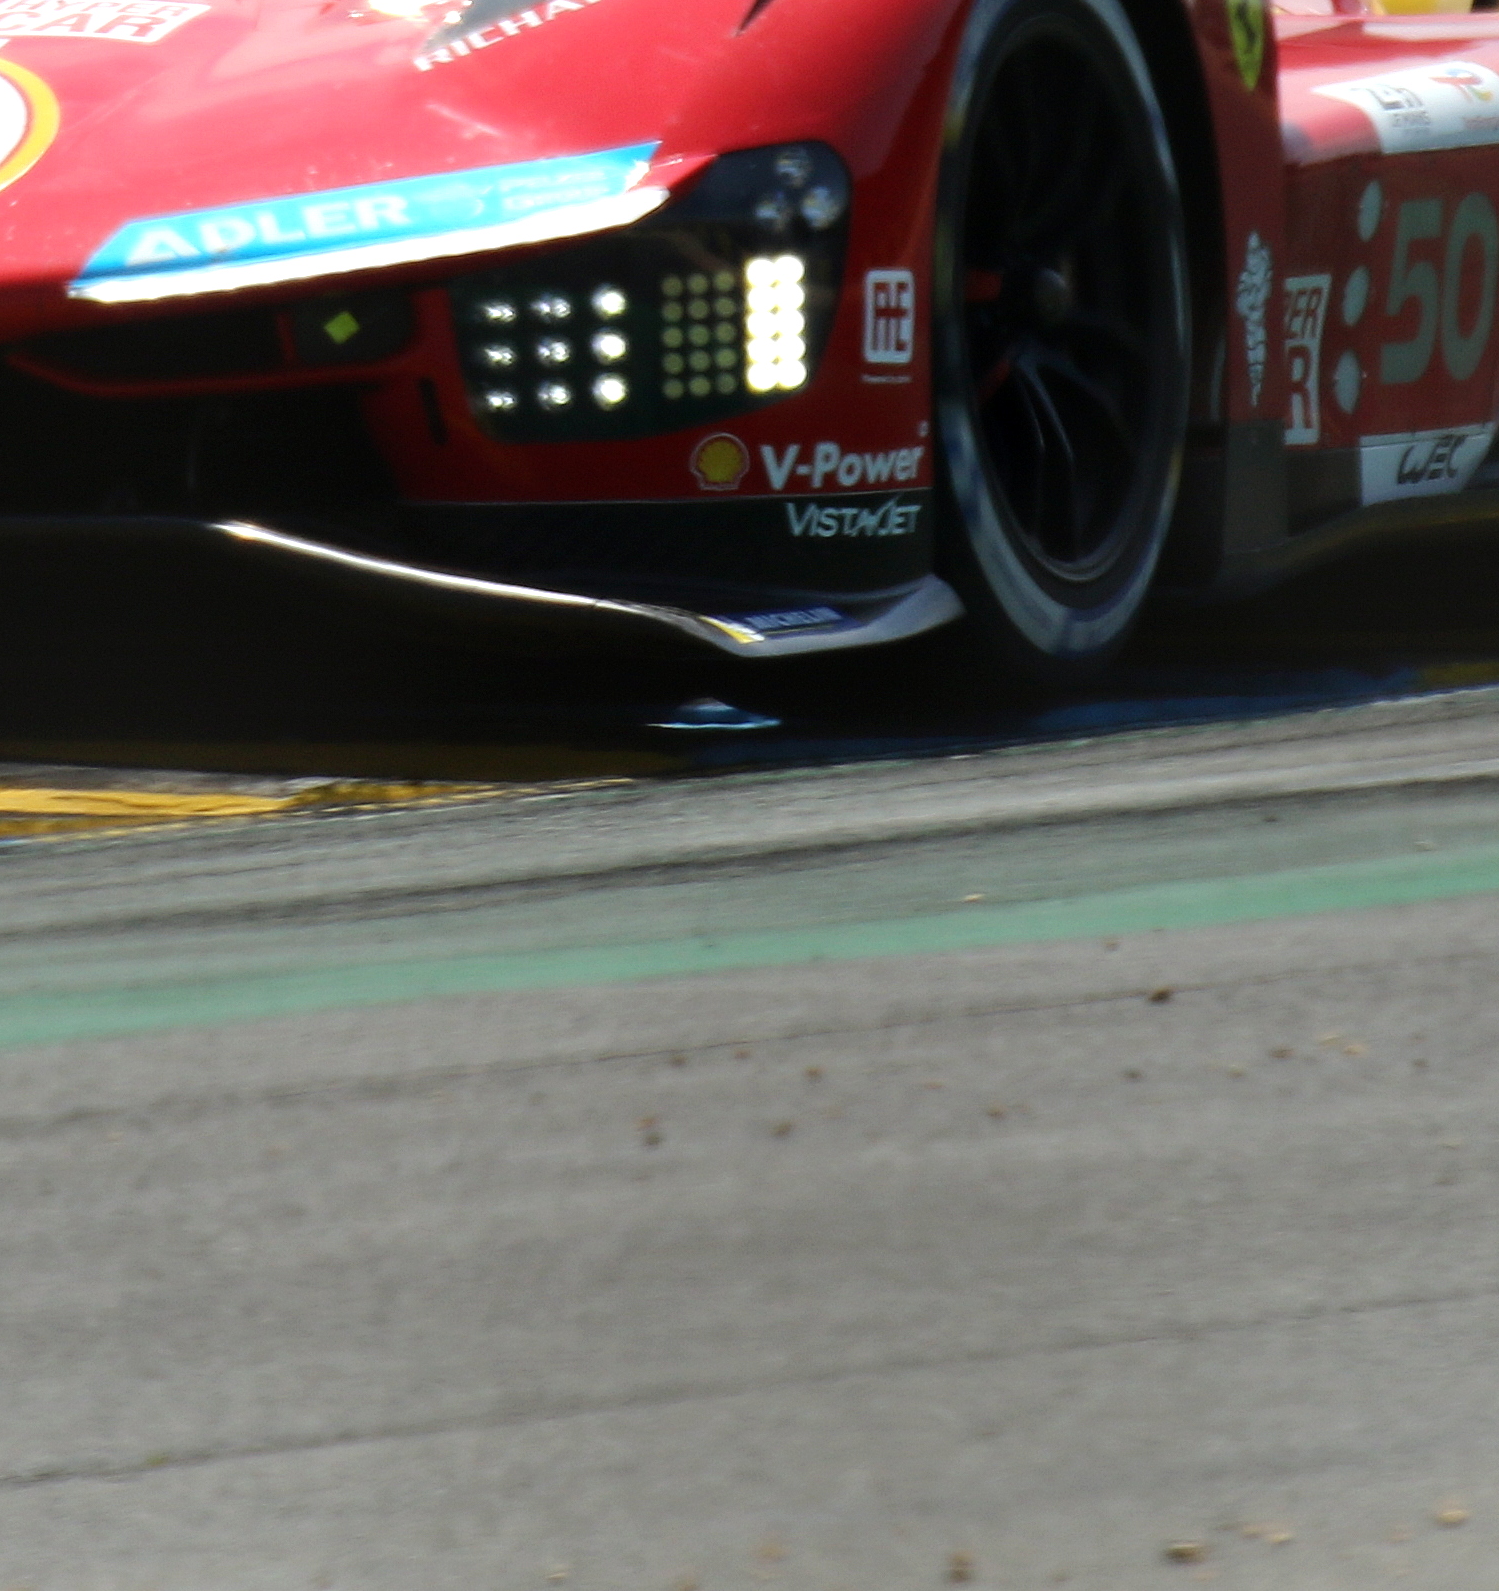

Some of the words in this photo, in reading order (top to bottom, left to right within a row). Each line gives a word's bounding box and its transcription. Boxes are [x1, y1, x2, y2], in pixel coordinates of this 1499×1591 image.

[125, 194, 411, 265] ADLER
[1380, 190, 1499, 386] 50
[760, 441, 924, 490] V-Power
[1396, 433, 1468, 485] WEC
